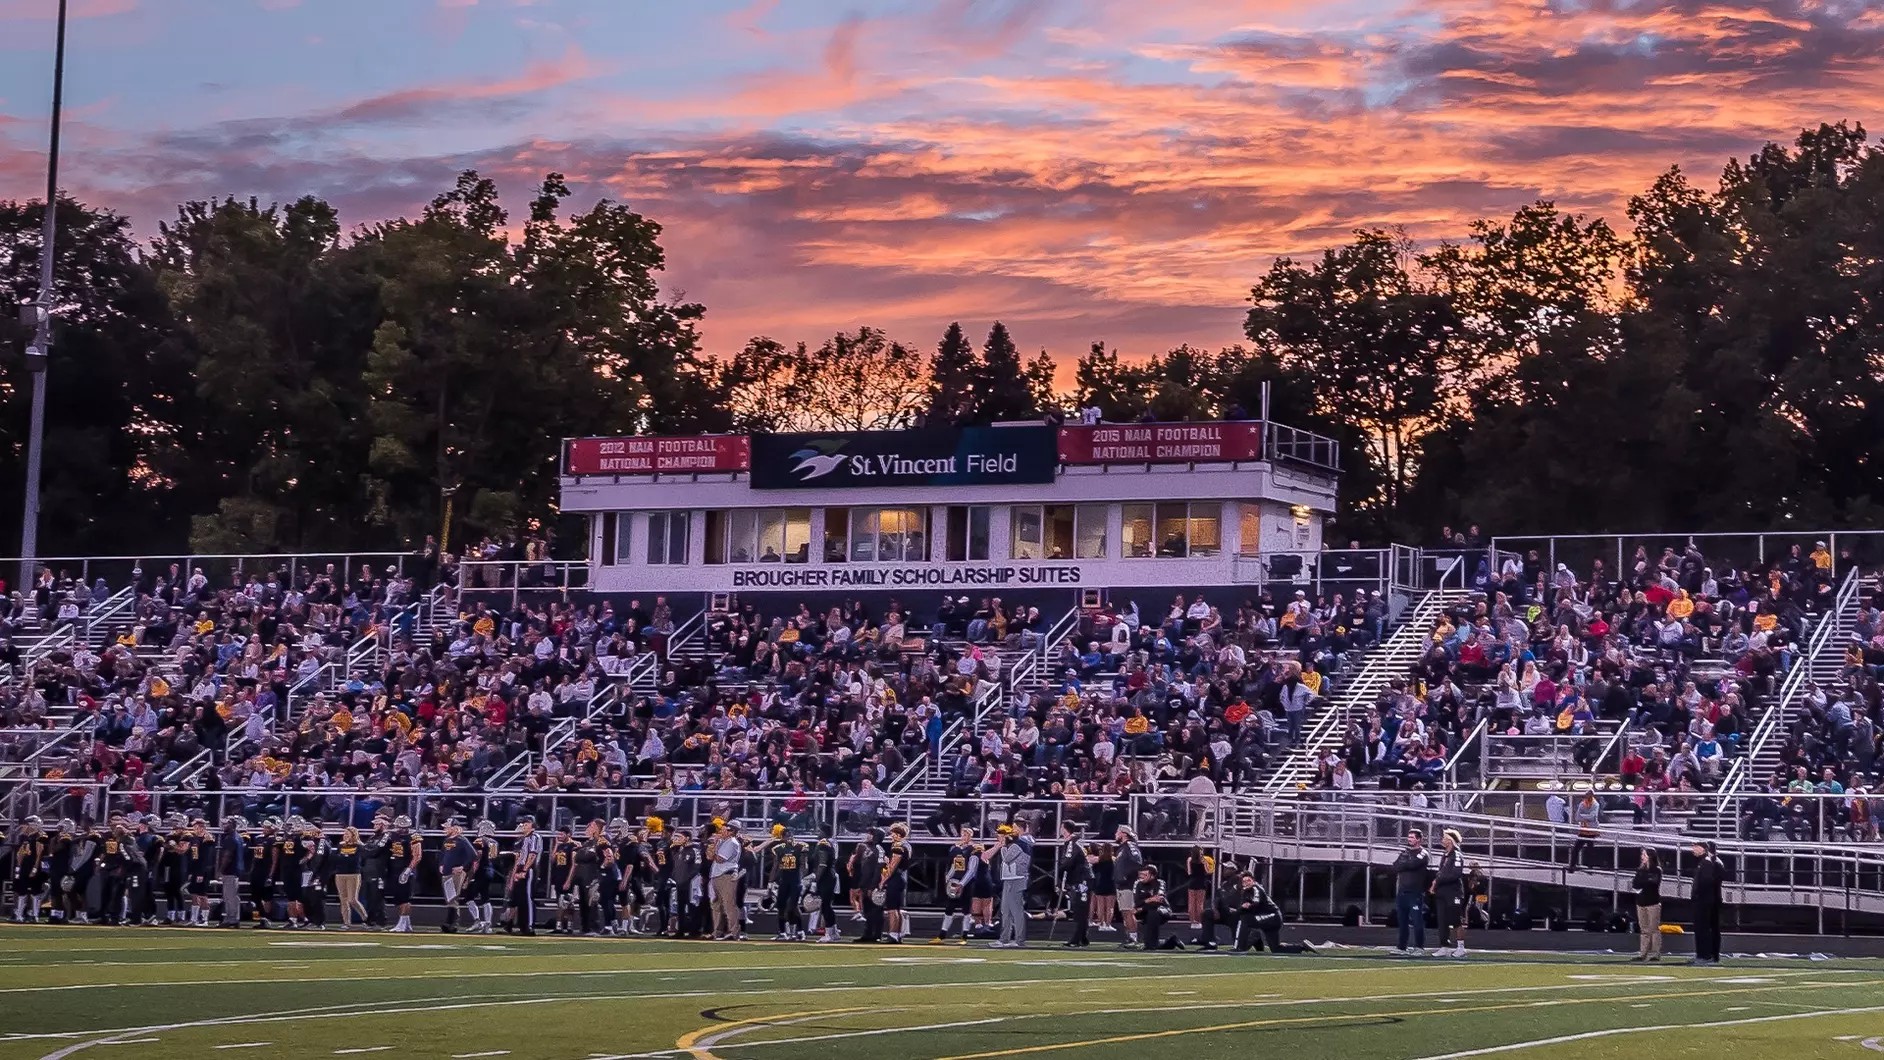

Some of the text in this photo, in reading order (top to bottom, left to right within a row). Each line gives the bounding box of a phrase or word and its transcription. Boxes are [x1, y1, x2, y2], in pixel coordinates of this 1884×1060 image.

[1092, 427, 1222, 443] 2015 NAIA FOOTBALL
[600, 440, 717, 454] 2012 NAIA FOOTBALL
[1092, 444, 1221, 459] NATIONAL CHAMPION
[600, 456, 716, 470] NATIONAL CHAMPION
[876, 454, 957, 475] Vincent
[966, 453, 1017, 473] Field
[733, 566, 1081, 586] BROUGHER FAMILY SCHOLARSHIP SUITES
